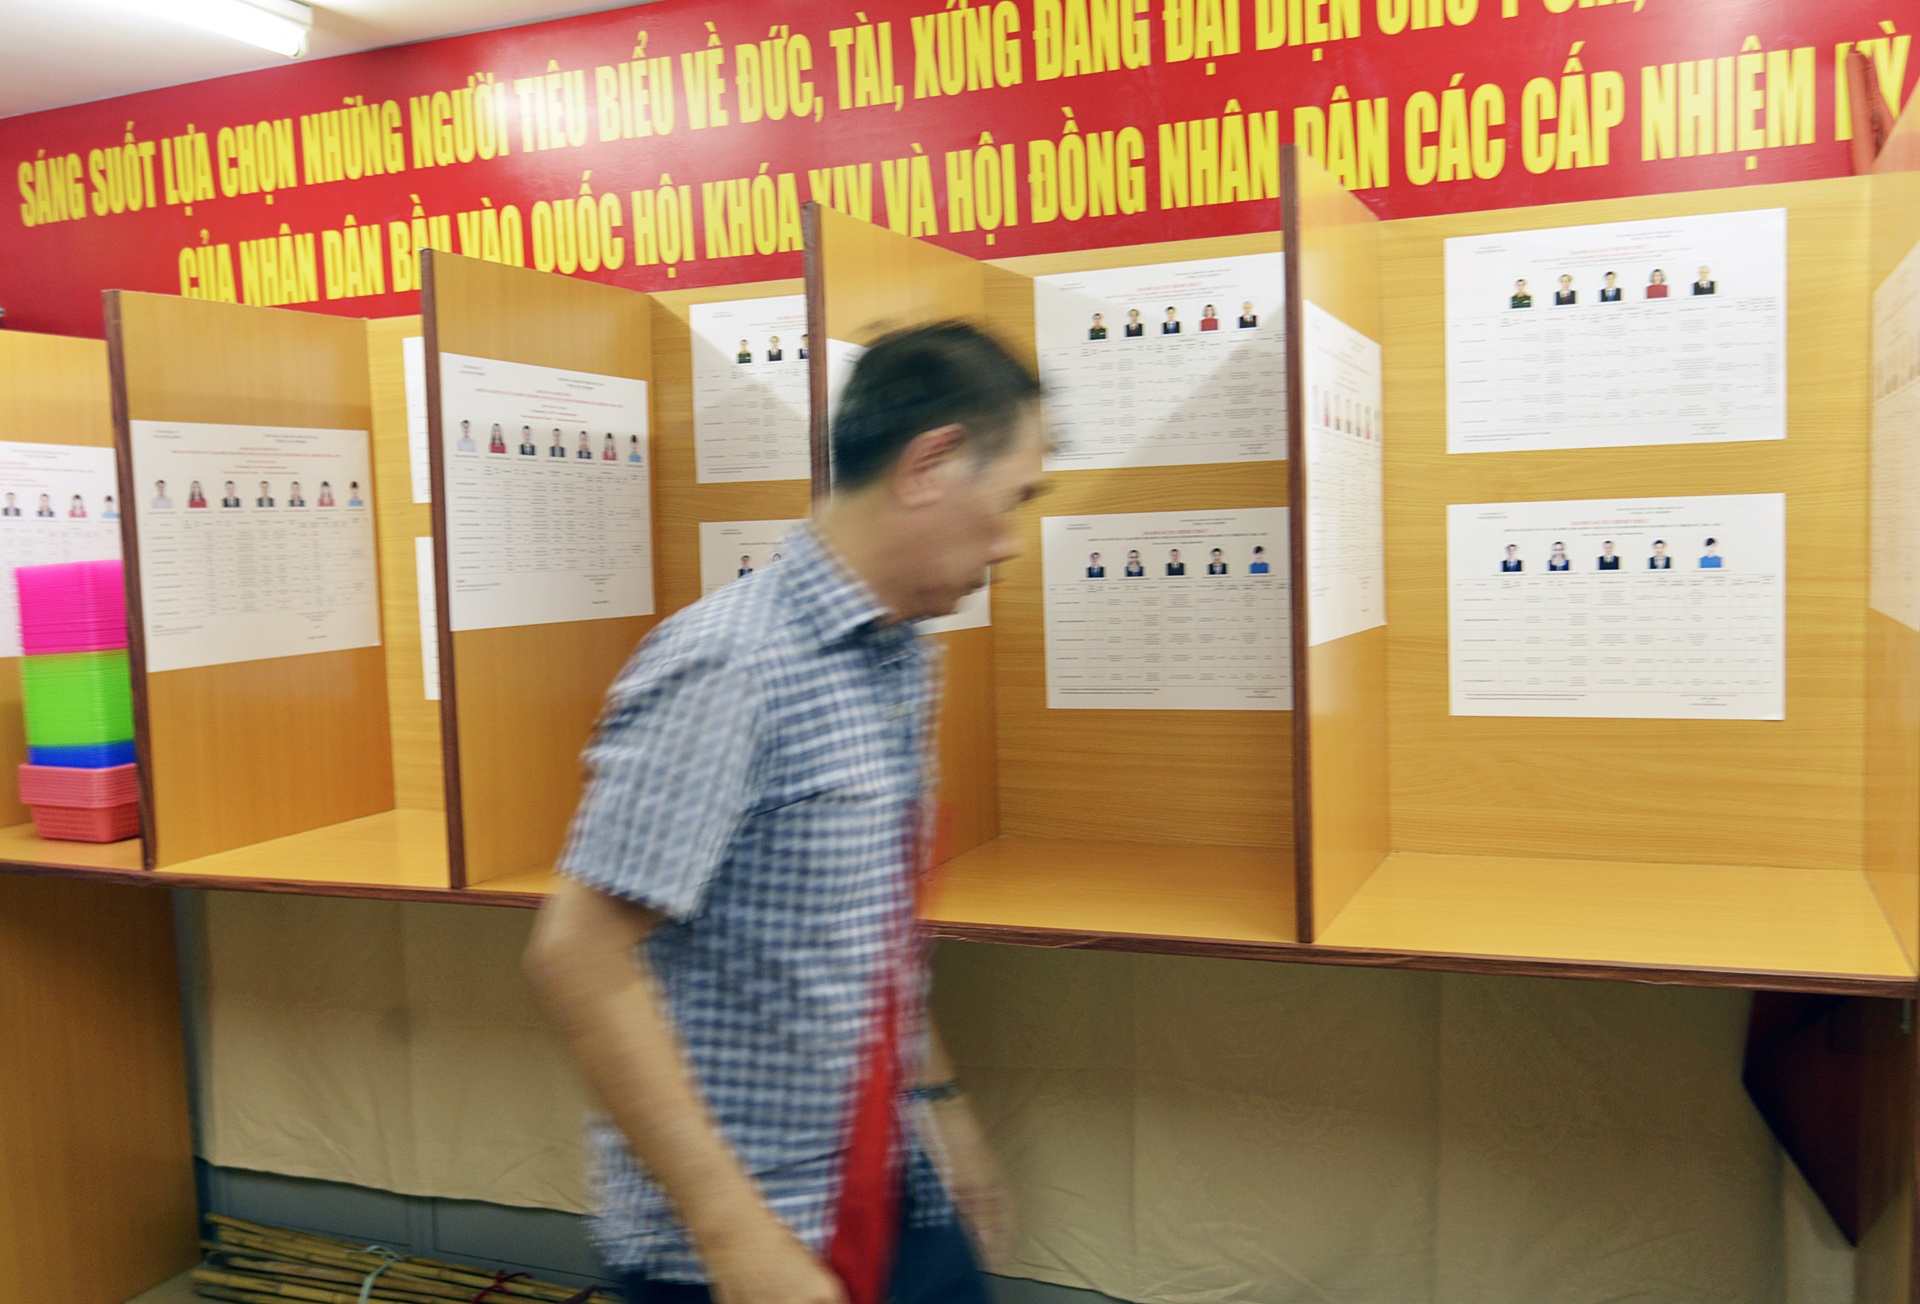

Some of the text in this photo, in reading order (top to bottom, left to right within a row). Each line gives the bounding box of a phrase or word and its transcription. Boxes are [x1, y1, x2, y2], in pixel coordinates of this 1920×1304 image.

[18, 149, 87, 227] SÁNG
[88, 121, 156, 217] SUỐT
[161, 124, 216, 216] LỰA
[217, 118, 297, 205] CHỌN
[300, 95, 405, 185] NHỮNG
[409, 72, 510, 169] NGƯỜI
[513, 59, 589, 153] TIÊU
[595, 31, 675, 142] BIỂU
[680, 21, 729, 130] VỀ
[735, 25, 824, 123] ĐỨC,
[829, 12, 904, 112] TÀI,
[910, 0, 1023, 99] XỨNG
[1162, 0, 1240, 75] ĐẠI
[178, 229, 237, 304] CỦA
[239, 223, 319, 307] NHÂN
[322, 214, 385, 300] DÂN
[531, 170, 624, 275] QUỐC
[632, 173, 695, 278] HỘI
[702, 162, 804, 259] KHÓA
[881, 143, 938, 238] VÀ
[945, 131, 1018, 245] HỘI
[1028, 106, 1146, 224] ĐỒNG
[1158, 99, 1280, 210] NHÂN
[1405, 73, 1506, 186] CÁC
[1521, 41, 1625, 174] CẤP
[1641, 35, 1816, 170] NHIỆM
